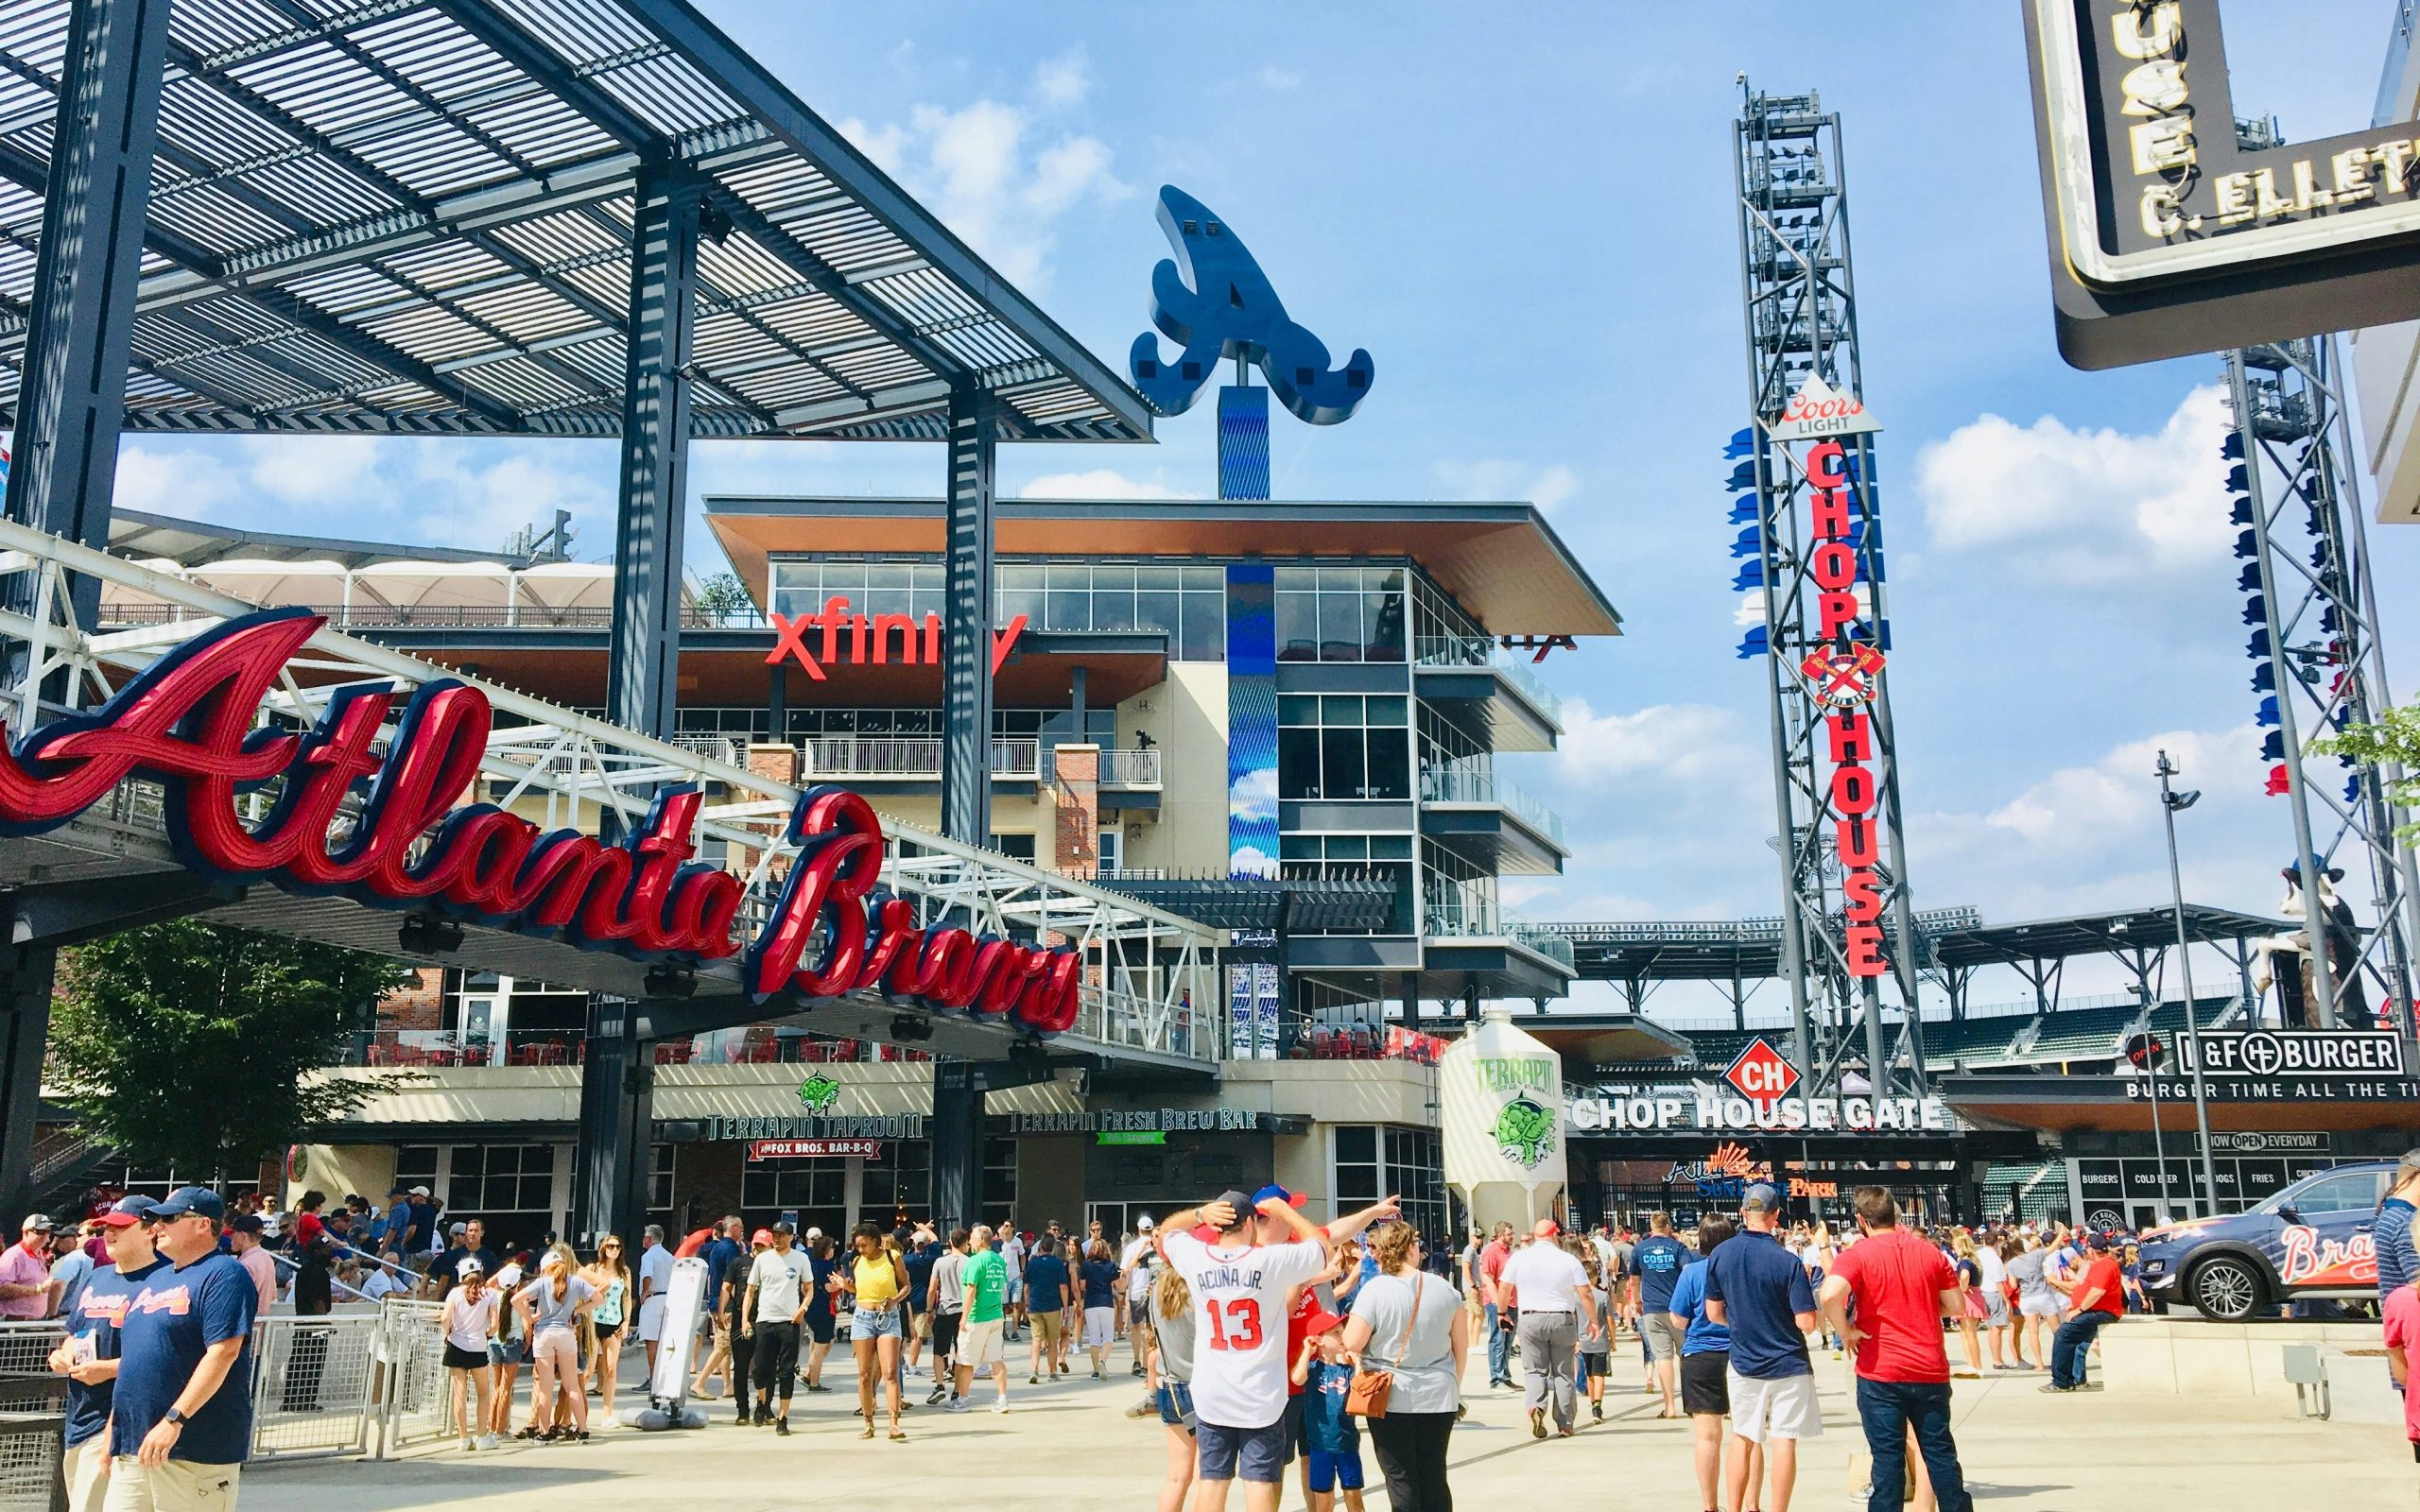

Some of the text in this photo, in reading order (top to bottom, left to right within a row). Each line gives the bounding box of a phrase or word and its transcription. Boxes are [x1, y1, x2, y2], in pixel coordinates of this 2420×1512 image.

[2112, 0, 2196, 176] USE
[2140, 139, 2419, 237] C. ELLET
[1783, 393, 1863, 422] Coors
[1799, 417, 1849, 434] LIGHT
[1806, 441, 1858, 640] CHOP
[765, 595, 1028, 681] xfiniy
[0, 607, 747, 962] Atlanta
[1826, 713, 1887, 977] HOUSE
[744, 784, 1080, 1040] Braves
[2285, 1040, 2394, 1069] BURGER
[1741, 1061, 1786, 1091] CH
[2229, 1083, 2282, 1097] TIME
[2295, 1083, 2335, 1097] ALL
[2346, 1083, 2387, 1096] THE
[706, 1111, 924, 1141] TERRAPIN TAPROOM
[1008, 1107, 1257, 1133] TERRAPIN FRESH BREW BAR
[1571, 1098, 1945, 1128] CHOP HOUSE GATE
[771, 1143, 792, 1153] FOX
[795, 1143, 825, 1153] BROS.
[829, 1142, 872, 1153] BAR-B-Q
[2234, 1135, 2262, 1146] OPEN
[2268, 1135, 2317, 1146] EVERYDAY
[1789, 1178, 1838, 1197] PARK
[2083, 1174, 2118, 1184] BURGERS
[2135, 1174, 2178, 1184] COLD BER
[2195, 1174, 2206, 1184] HO
[2252, 1173, 2274, 1183] FRIES
[1643, 1254, 1675, 1264] COSTA
[2281, 1224, 2377, 1285] Bra
[1198, 1265, 1262, 1292] ACUÑA JR.
[1206, 1298, 1263, 1351] 13
